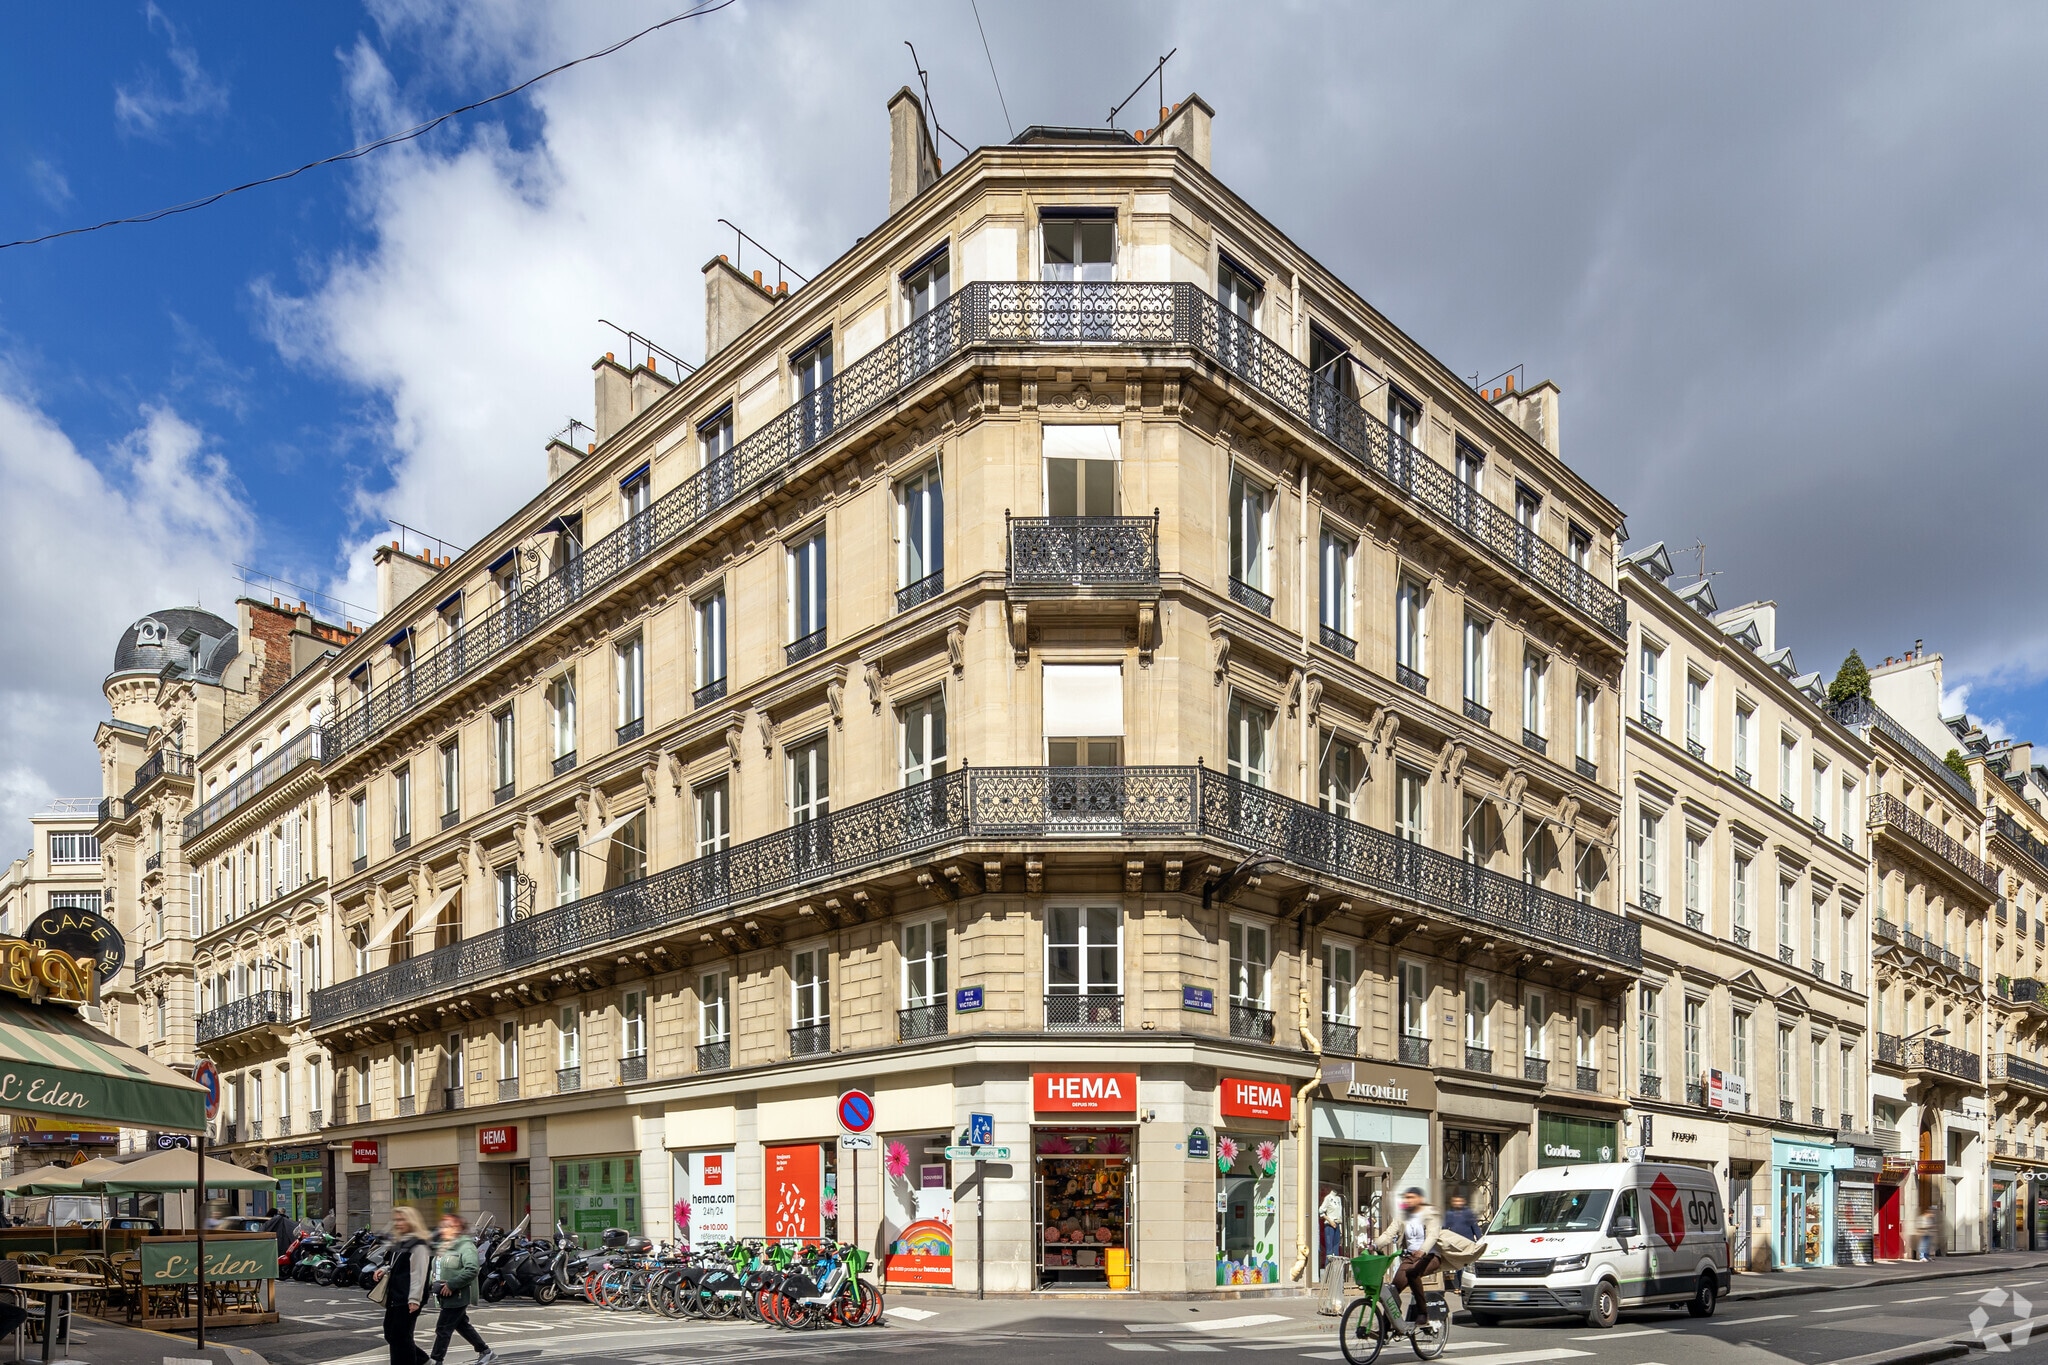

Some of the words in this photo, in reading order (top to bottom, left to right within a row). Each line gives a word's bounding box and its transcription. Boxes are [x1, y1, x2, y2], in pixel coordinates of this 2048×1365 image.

[1193, 989, 1203, 997] RUE
[959, 1000, 980, 1008] VICTOIRE
[1047, 1078, 1122, 1099] HEMA
[1729, 1081, 1742, 1095] LOUER
[1237, 1084, 1283, 1108] HEMA
[482, 1129, 506, 1145] HEMA
[355, 1148, 377, 1156] HEMA
[705, 1166, 722, 1174] HEMA
[589, 1197, 603, 1208] BIO
[692, 1194, 735, 1204] hema.com
[1688, 1190, 1718, 1233] dpd
[703, 1223, 710, 1231] de
[710, 1223, 728, 1231] 10.000
[155, 1254, 263, 1279] L'Eden
[923, 1265, 951, 1273] hema.com
